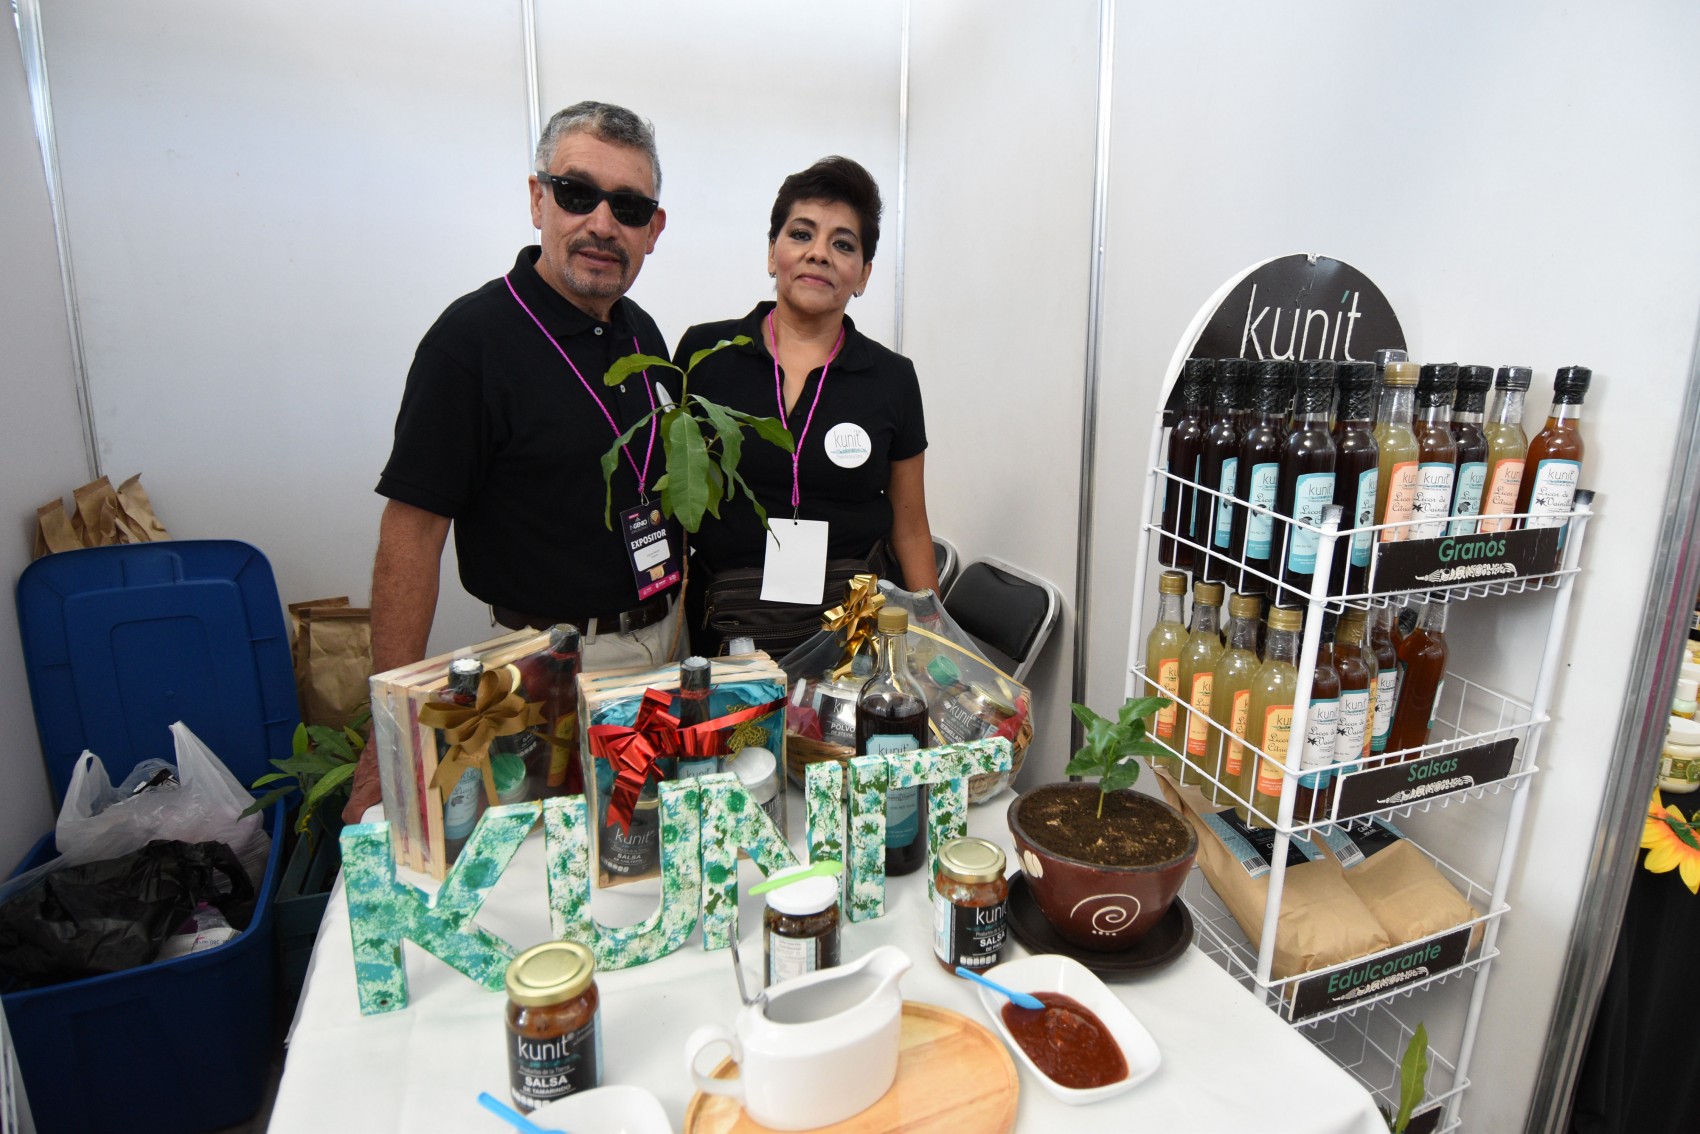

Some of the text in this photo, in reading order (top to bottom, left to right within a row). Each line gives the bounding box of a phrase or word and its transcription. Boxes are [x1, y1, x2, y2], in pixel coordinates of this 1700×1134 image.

[630, 529, 667, 550] EXPOSITOR
[1438, 539, 1506, 562] Granos
[831, 723, 856, 733] POLVO
[1407, 757, 1459, 782] Salsas
[980, 930, 1006, 948] SALSA
[1327, 943, 1441, 993] Edulcorante
[525, 1075, 568, 1088] SALSA
